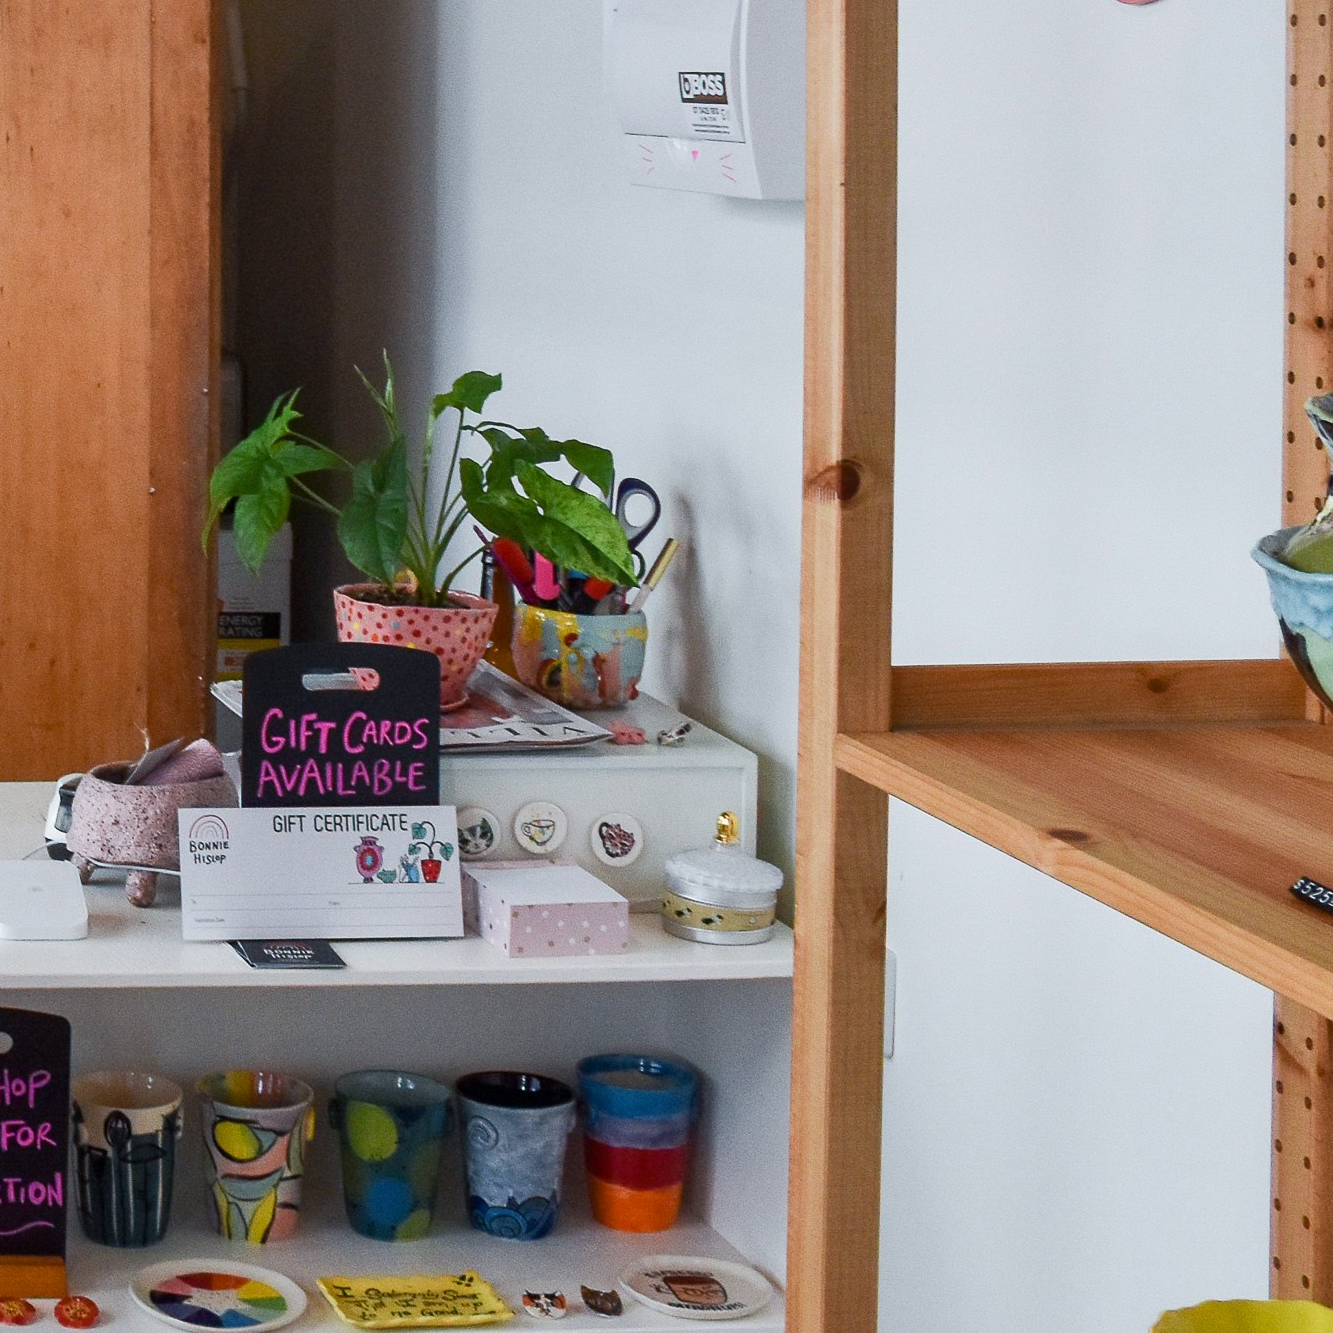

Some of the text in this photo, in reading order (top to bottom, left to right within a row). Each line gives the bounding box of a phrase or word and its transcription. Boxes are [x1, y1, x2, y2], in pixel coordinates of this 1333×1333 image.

[691, 74, 724, 96] BOSS
[219, 615, 263, 626] ENERGY
[219, 627, 264, 638] RATING
[261, 708, 429, 754] GIFT CARDS
[258, 759, 426, 798] AVAILABLE
[272, 813, 408, 833] GIFT CERTIFICATE
[189, 840, 230, 853] BONNIE
[193, 853, 227, 865] HISLOP
[0, 1120, 58, 1152] FOR
